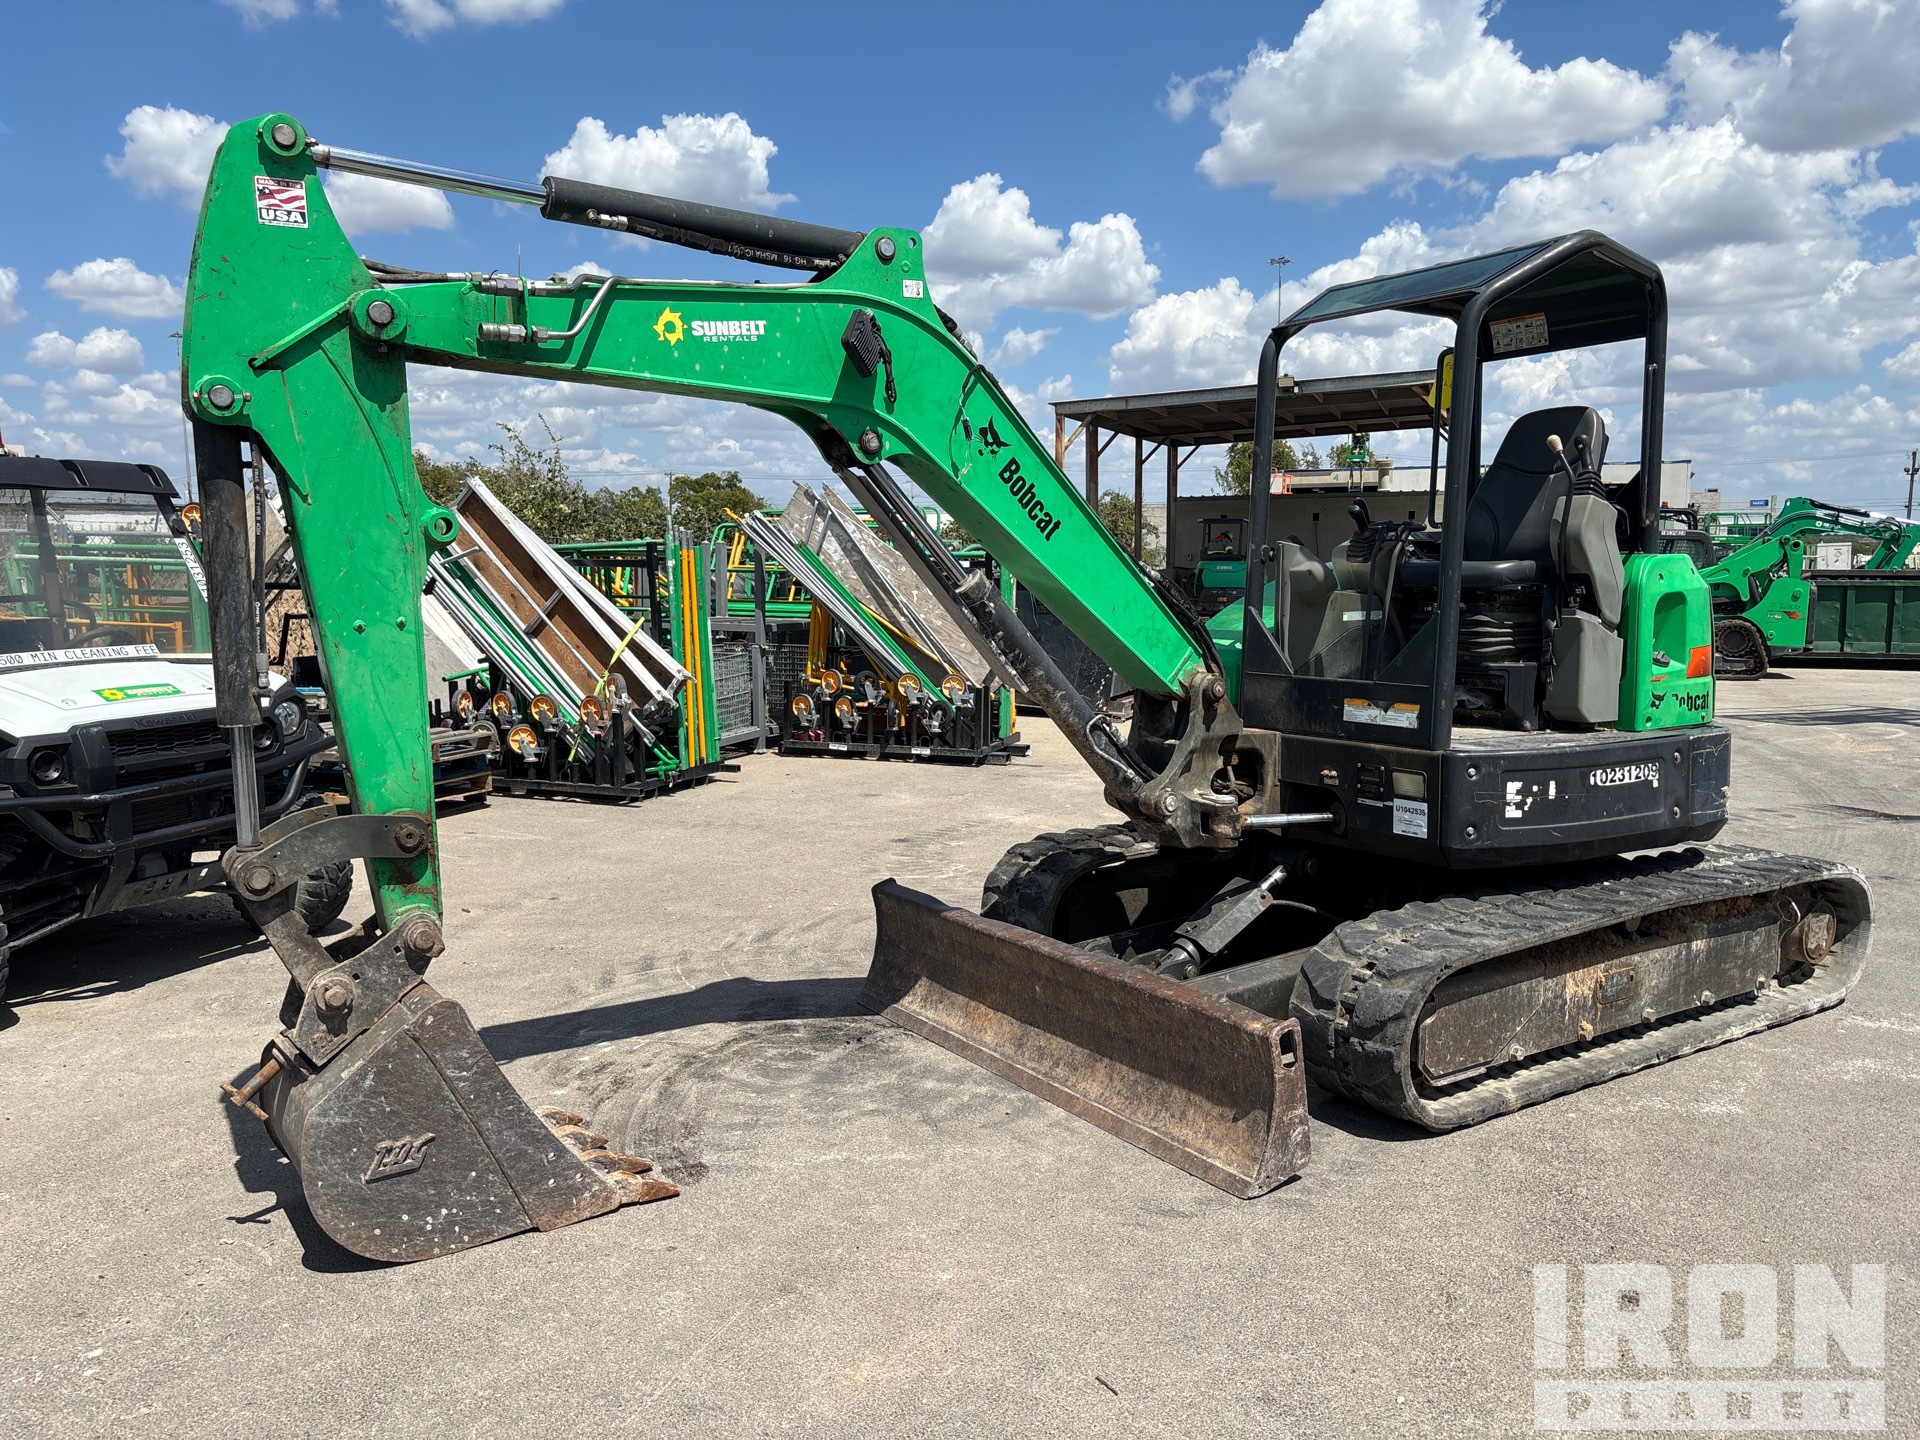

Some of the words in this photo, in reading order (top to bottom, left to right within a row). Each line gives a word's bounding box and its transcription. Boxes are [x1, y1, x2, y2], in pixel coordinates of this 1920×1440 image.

[261, 208, 304, 223] USA
[691, 320, 767, 336] SUNBELT
[998, 456, 1062, 542] Bobcat
[30, 651, 57, 663] MIN
[64, 646, 129, 660] CLEANING
[135, 644, 159, 655] FEE
[134, 713, 197, 728] Kawasaki
[1590, 762, 1659, 785] 10231209
[1395, 805, 1426, 817] U1042535
